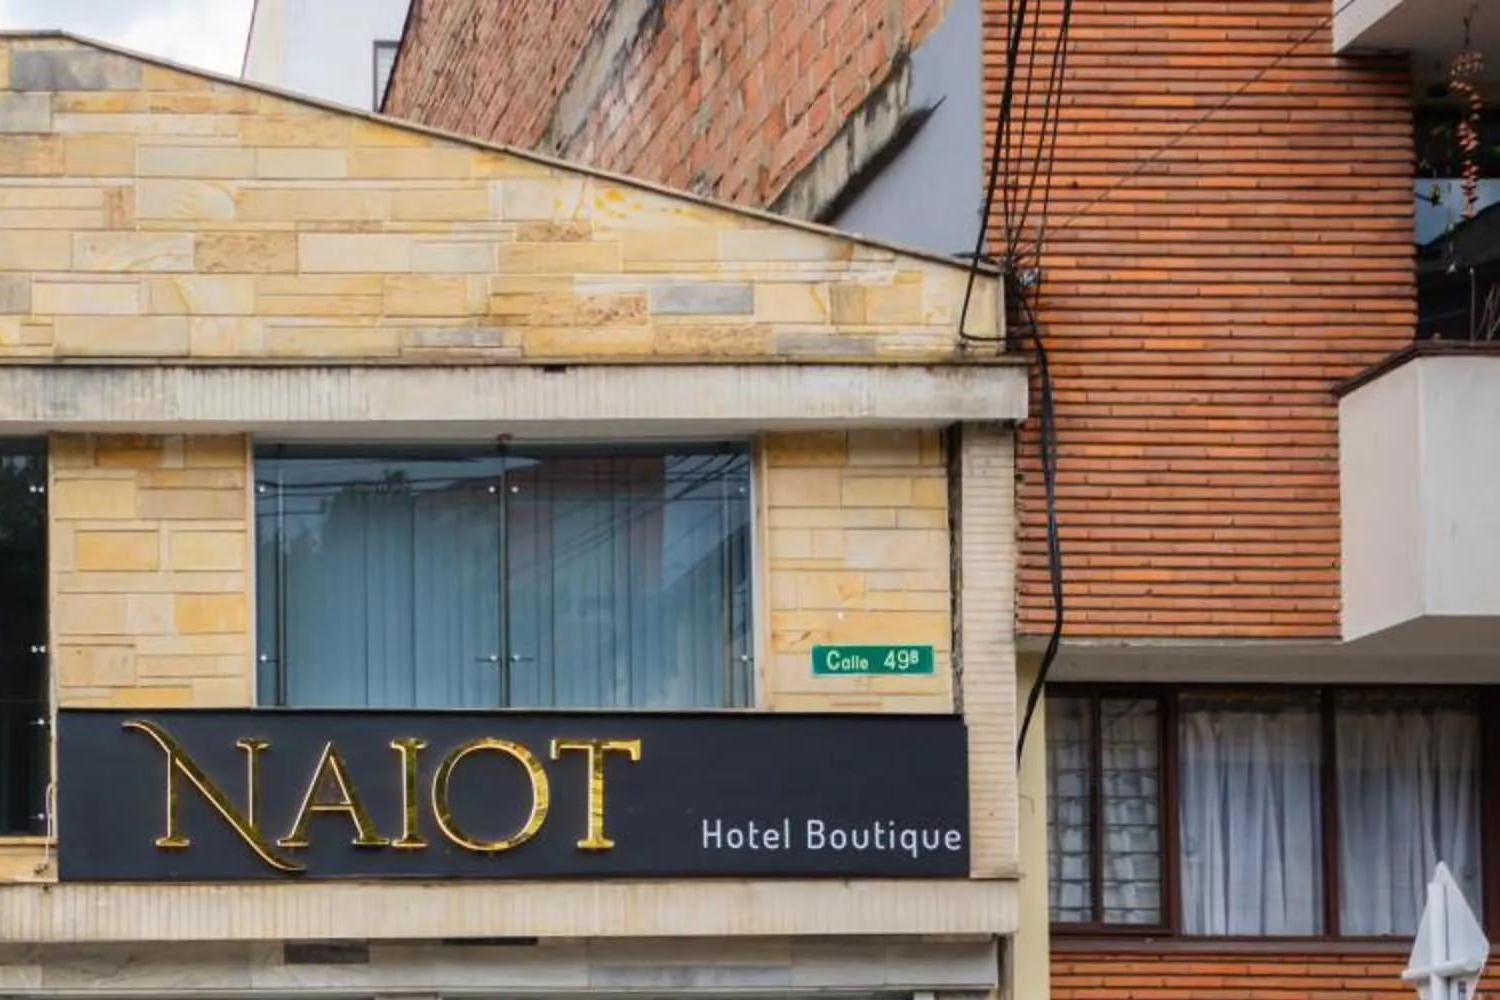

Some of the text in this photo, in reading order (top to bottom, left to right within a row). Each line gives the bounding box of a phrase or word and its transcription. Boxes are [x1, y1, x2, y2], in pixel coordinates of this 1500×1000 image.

[826, 649, 919, 670] Calle 49B
[122, 719, 642, 870] NAIOT
[702, 818, 963, 859] Hotel Boutique
